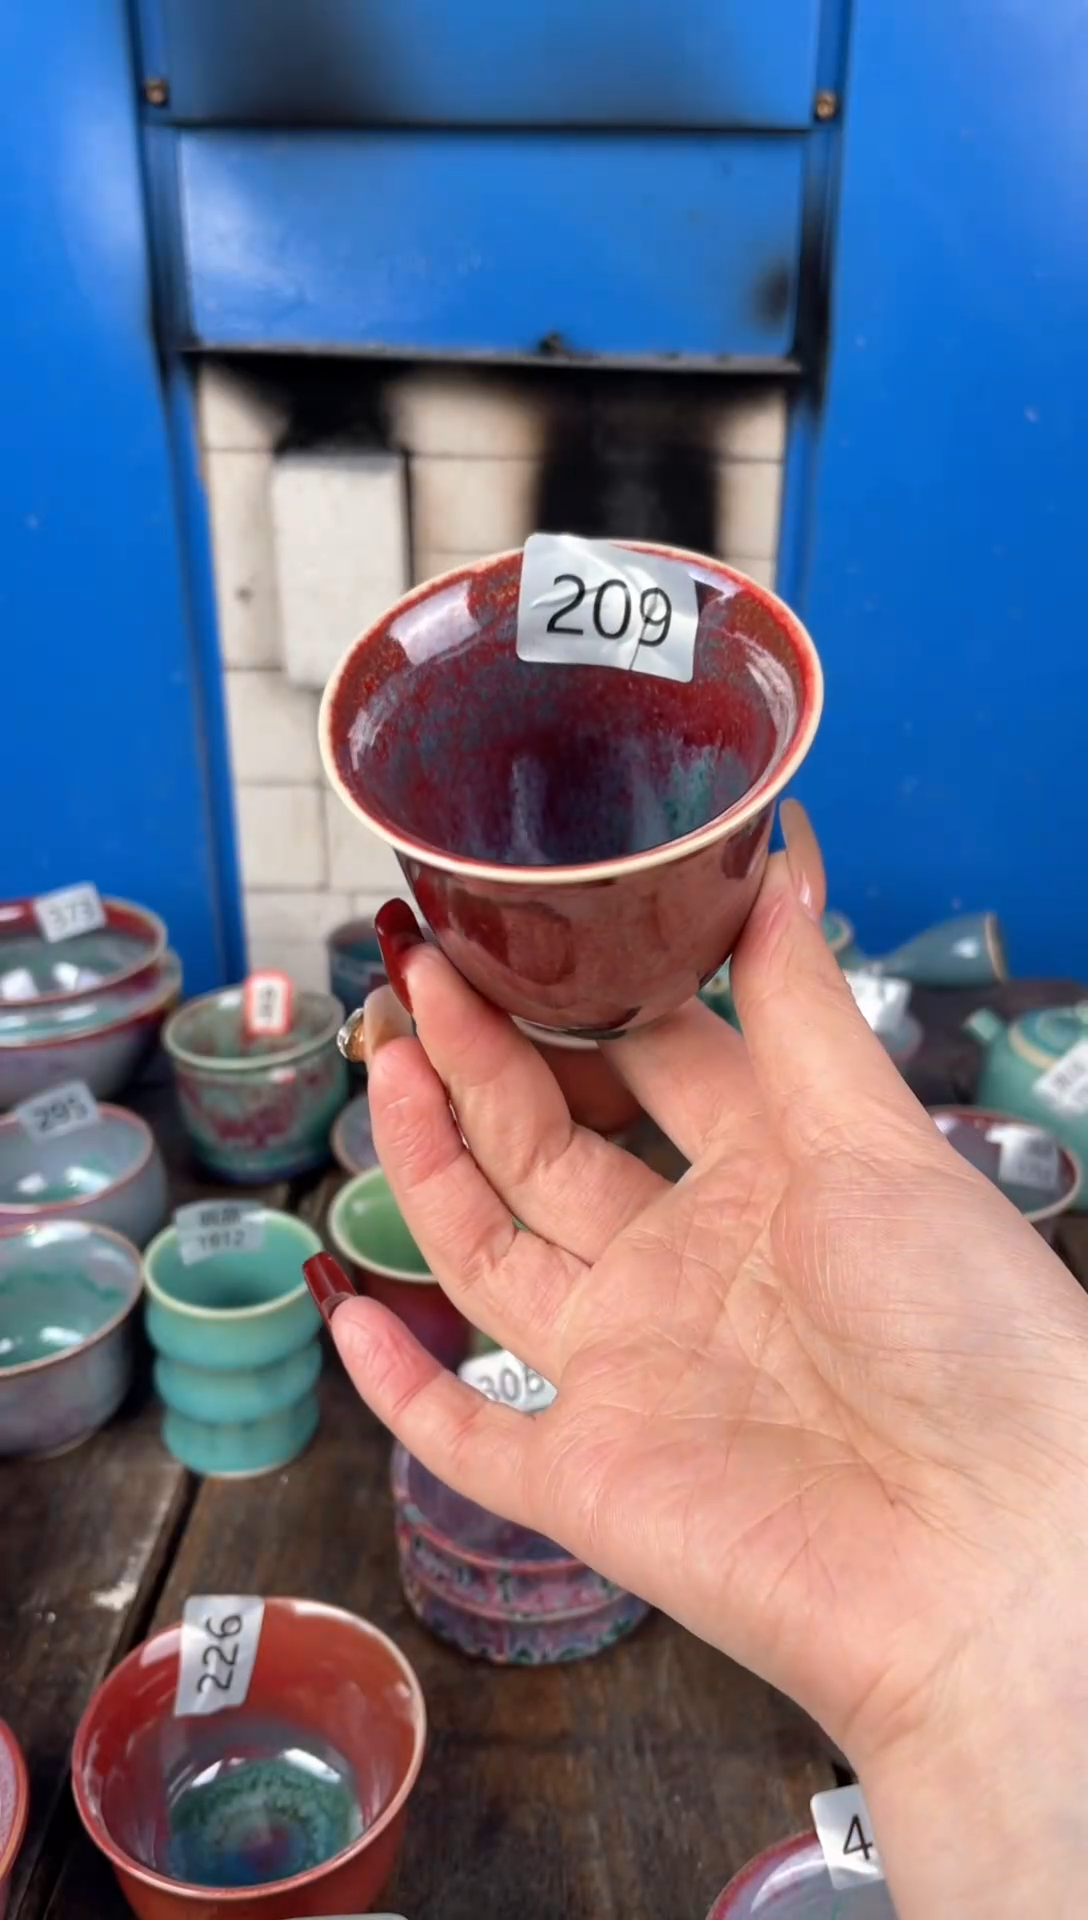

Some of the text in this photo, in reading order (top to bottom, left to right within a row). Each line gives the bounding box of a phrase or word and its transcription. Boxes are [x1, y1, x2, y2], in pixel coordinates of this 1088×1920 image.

[546, 573, 672, 647] 209
[478, 1366, 546, 1402] 306
[197, 1614, 243, 1694] 226
